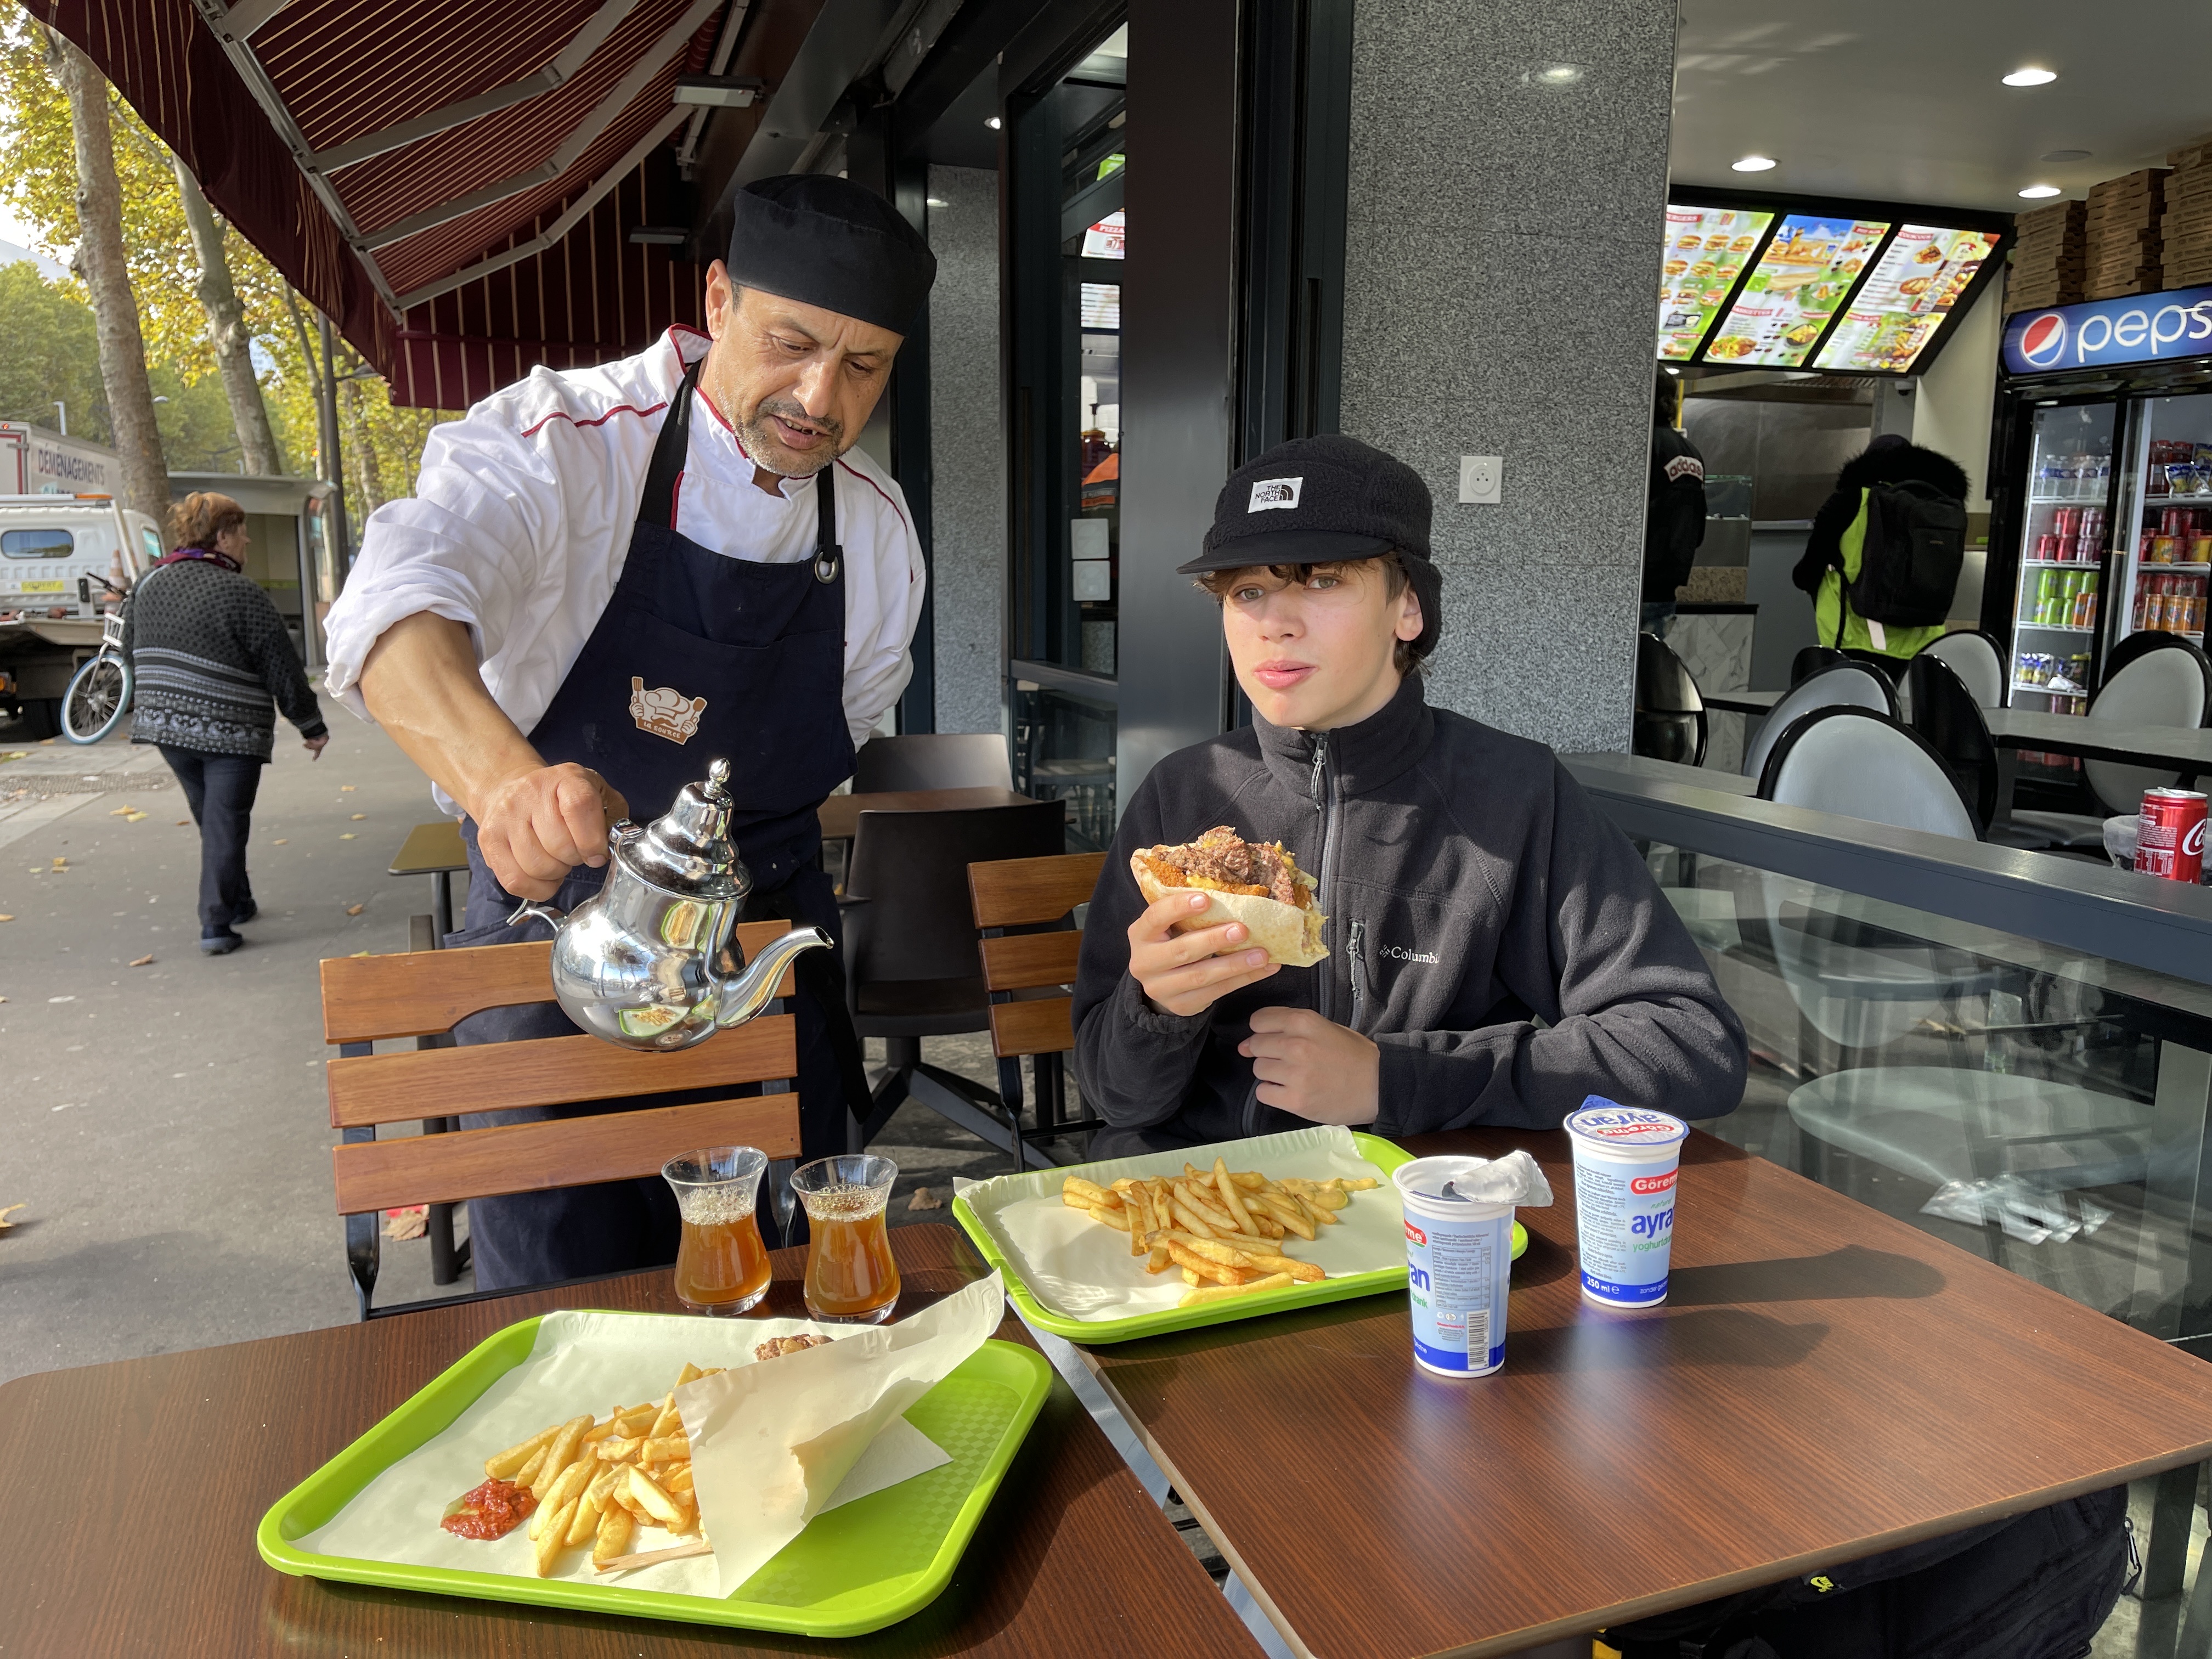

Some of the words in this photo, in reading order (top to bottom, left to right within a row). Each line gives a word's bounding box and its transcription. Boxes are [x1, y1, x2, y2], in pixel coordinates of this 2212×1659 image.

[2078, 300, 2212, 363] peps
[38, 443, 104, 486] DÉMÉNAGEMENTS
[1255, 490, 1280, 499] NORTH
[654, 725, 681, 738] SOURCE
[1581, 1112, 1661, 1127] ayran
[1602, 1125, 1672, 1135] Göreme
[1635, 1171, 1678, 1191] Görem
[1631, 1208, 1673, 1239] ayra
[1587, 1277, 1600, 1289] 250
[1601, 1285, 1610, 1293] ml
